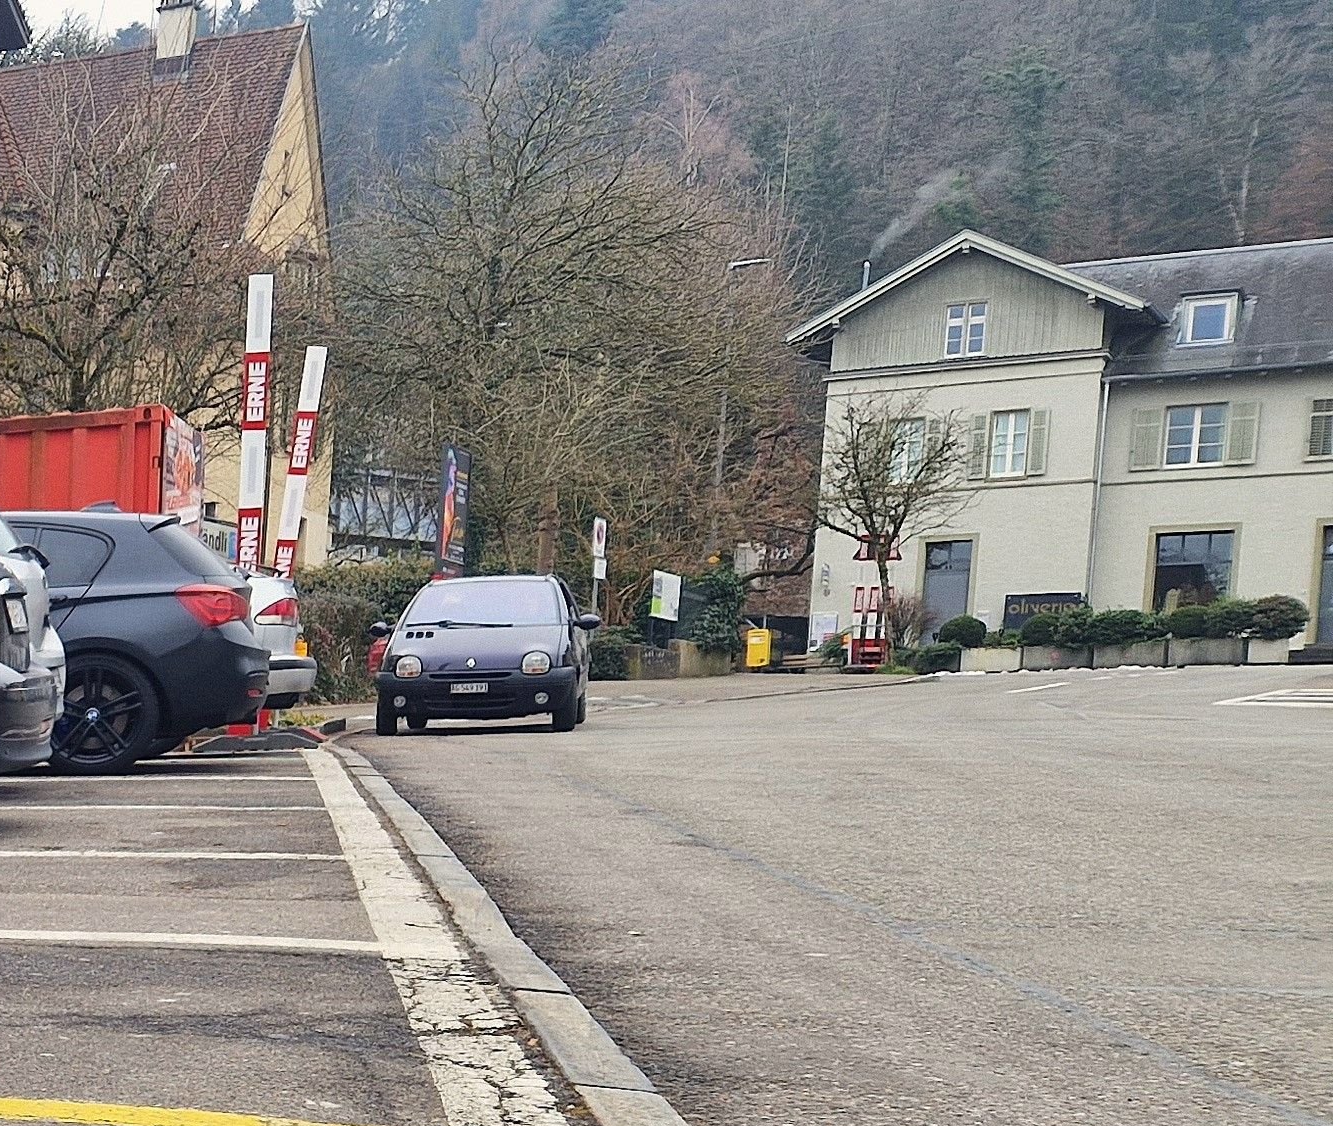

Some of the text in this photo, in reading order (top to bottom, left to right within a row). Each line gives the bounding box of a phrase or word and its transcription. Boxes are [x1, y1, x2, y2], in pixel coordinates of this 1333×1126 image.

[247, 362, 266, 421] ERNE
[292, 418, 313, 468] ERNE
[202, 528, 228, 554] ändli
